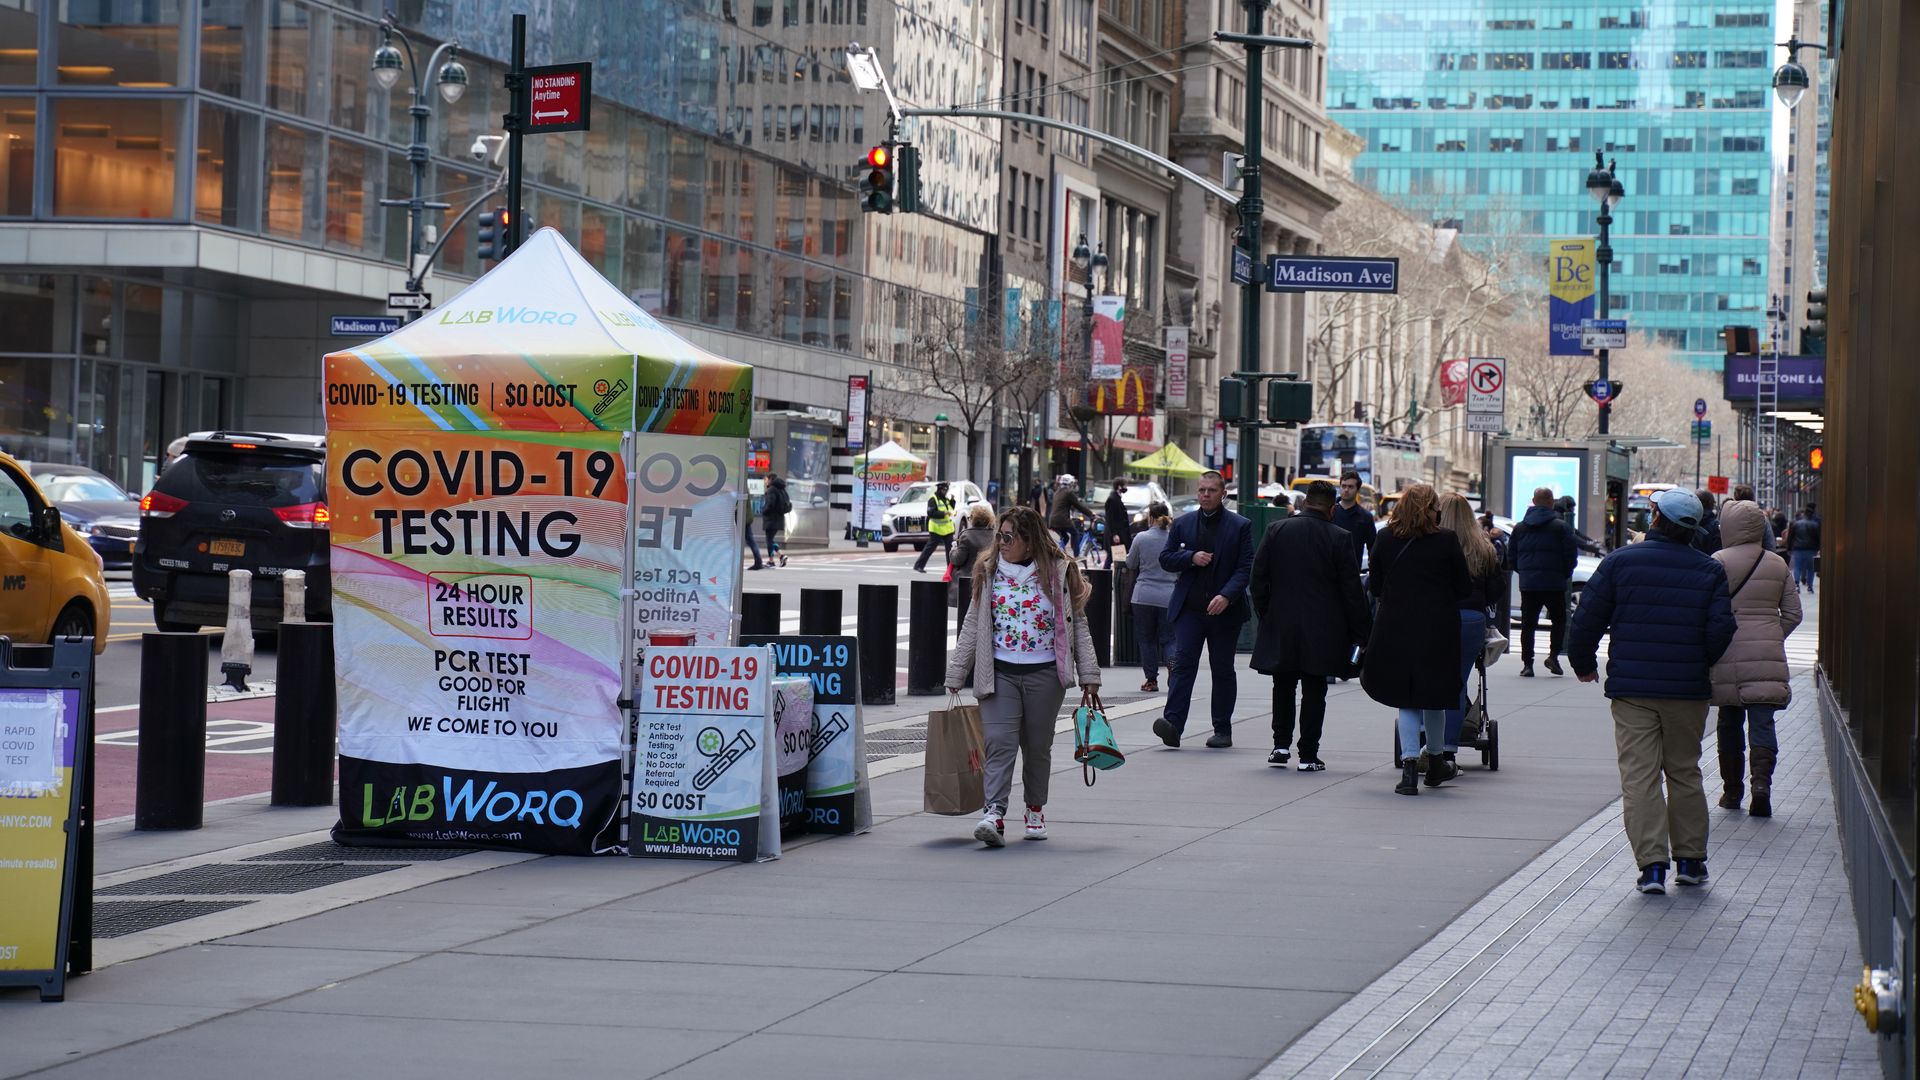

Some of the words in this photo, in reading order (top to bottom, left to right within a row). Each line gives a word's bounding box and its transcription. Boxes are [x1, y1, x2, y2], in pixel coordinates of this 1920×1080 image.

[534, 77, 544, 89] NO
[545, 76, 576, 88] STANDING
[534, 90, 560, 102] Anytime
[1277, 265, 1353, 283] Madison
[1358, 268, 1392, 284] Ave
[1556, 256, 1590, 283] Be
[334, 321, 376, 332] Madison
[378, 321, 398, 332] Ave
[1560, 323, 1581, 332] Berke
[1169, 353, 1185, 396] metro
[1808, 375, 1824, 384] LA
[328, 383, 406, 406] COVID-19
[410, 383, 479, 406] TESTING
[505, 382, 527, 408] $0
[533, 383, 578, 408] COST
[639, 386, 672, 409] COVID-19
[672, 388, 700, 411] TESTING
[718, 392, 735, 414] COST
[342, 448, 615, 498] COVID-19
[865, 482, 900, 492] ESTING
[374, 508, 582, 558] TESTING
[3, 575, 26, 591] NYC
[435, 582, 460, 602] 24
[467, 584, 524, 605] HOUR
[443, 606, 518, 629] RESULTS
[434, 650, 480, 674] PCR
[486, 652, 531, 676] TEST
[774, 644, 849, 667] VID-19
[650, 655, 758, 681] COVID-19
[438, 676, 492, 693] GOOD
[496, 679, 526, 696] FOR
[458, 696, 510, 713] FLIGHT
[654, 685, 749, 711] TESTING
[4, 726, 36, 736] RAPID
[408, 716, 432, 732] WE
[437, 718, 490, 735] COME
[494, 720, 517, 736] TO
[522, 721, 558, 738] YOU
[649, 722, 664, 730] PCR
[648, 732, 684, 742] Antibody
[798, 728, 811, 752] CO
[2, 741, 35, 751] COVID
[648, 742, 675, 752] Testing
[5, 756, 29, 765] TEST
[660, 752, 678, 760] Cost
[646, 760, 658, 768] No
[660, 761, 686, 769] Doctor
[645, 770, 676, 778] Referral
[644, 778, 680, 788] Required
[636, 790, 658, 810] $0
[662, 792, 706, 812] COST
[0, 815, 53, 828] HNYC.COM
[645, 843, 738, 858] www.labworq.com
[0, 946, 18, 960] OST
